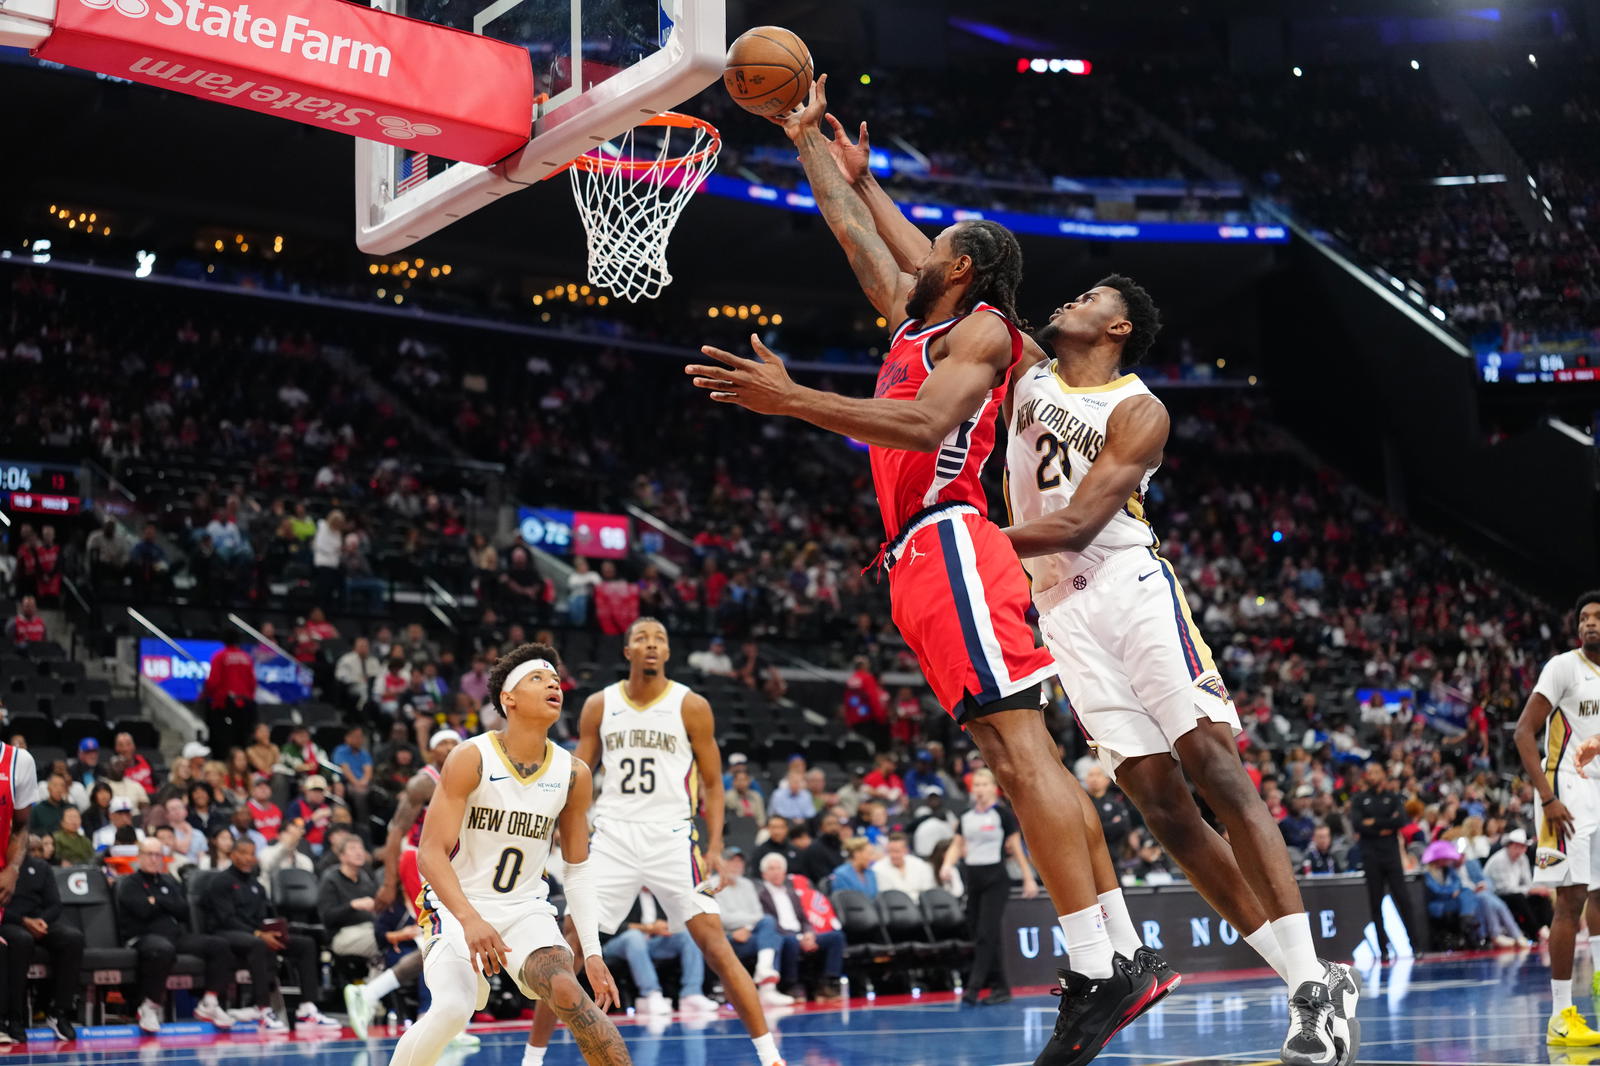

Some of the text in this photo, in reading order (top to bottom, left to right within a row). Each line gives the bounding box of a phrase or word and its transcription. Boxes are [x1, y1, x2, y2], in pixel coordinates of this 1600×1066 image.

[1016, 399, 1104, 463] NEW ORLEANS
[0, 466, 32, 492] :04
[1036, 432, 1072, 491] 21
[1578, 699, 1600, 718] NEW
[629, 729, 677, 754] ORLEANS
[620, 757, 656, 794] 25
[467, 807, 554, 841] NEW ORLEA
[67, 871, 89, 896] G
[492, 846, 524, 894] 0
[1017, 919, 1164, 959] UNR
